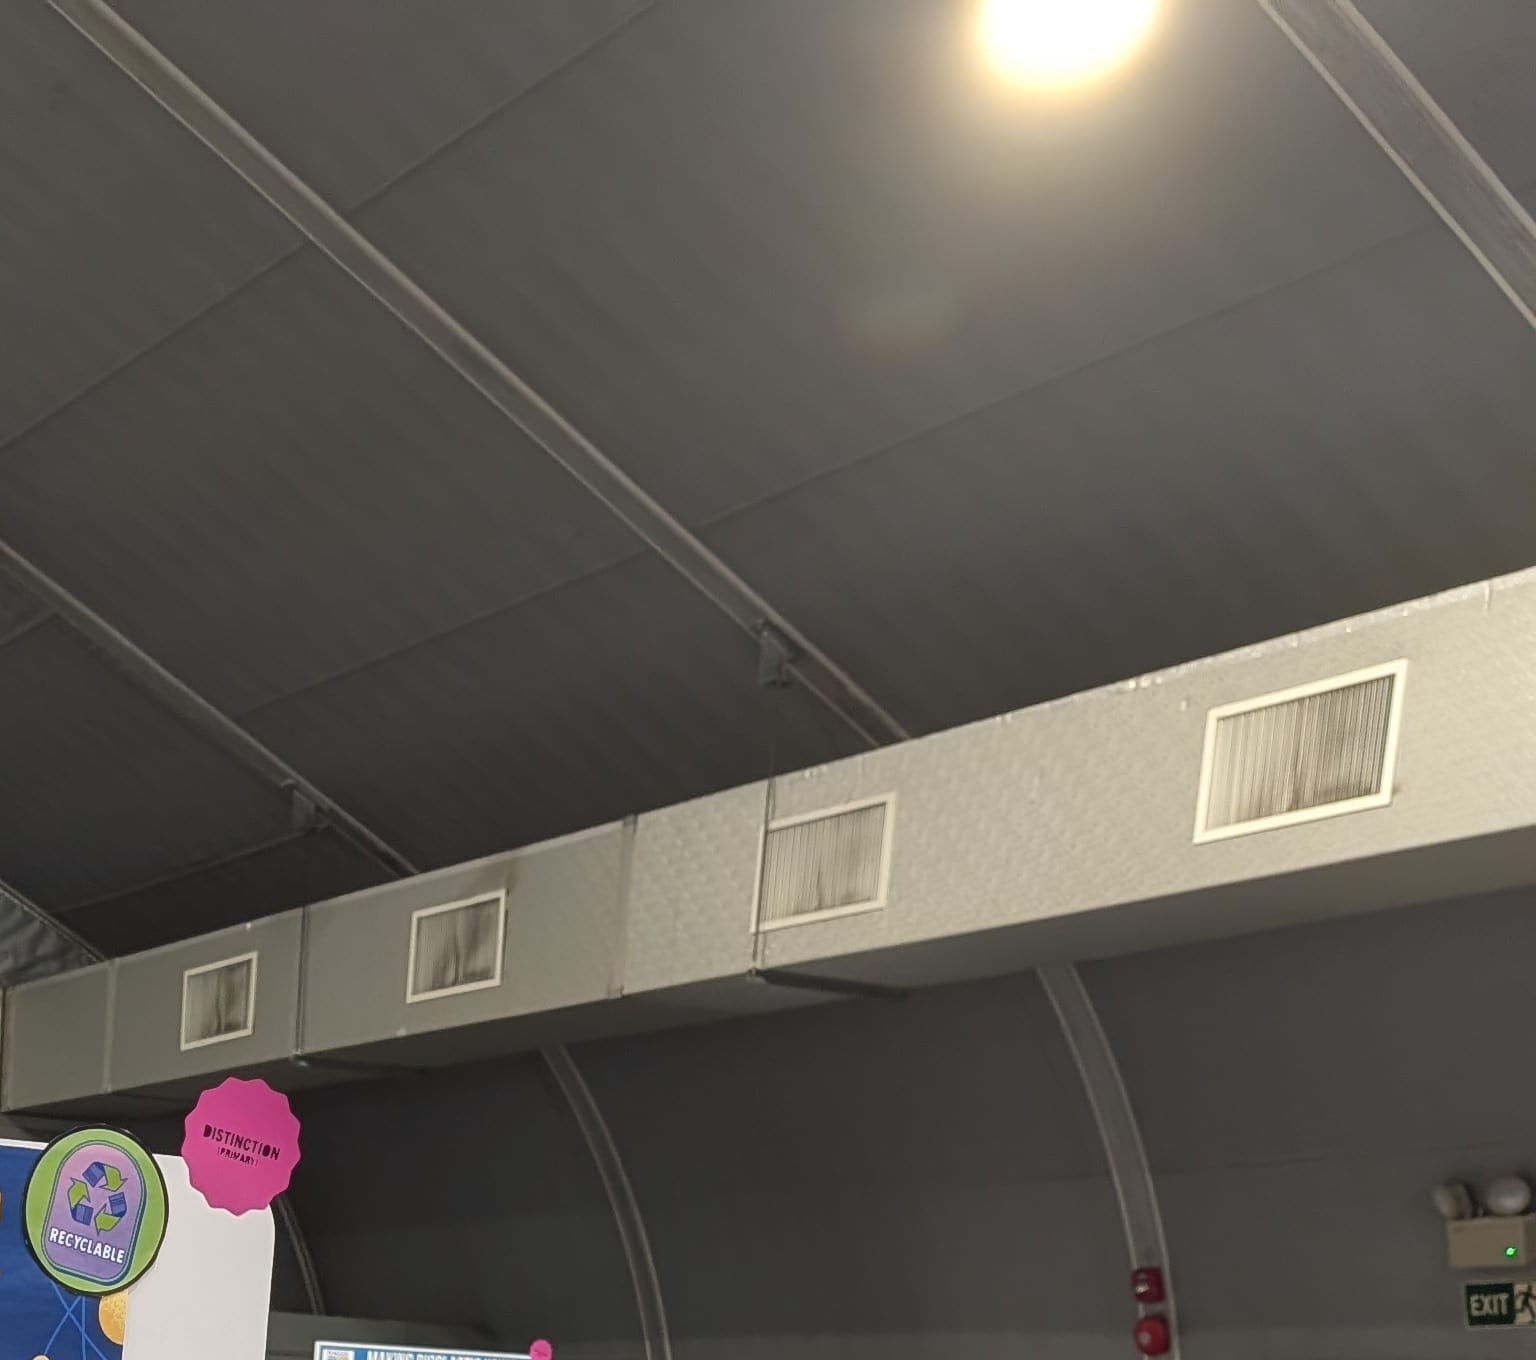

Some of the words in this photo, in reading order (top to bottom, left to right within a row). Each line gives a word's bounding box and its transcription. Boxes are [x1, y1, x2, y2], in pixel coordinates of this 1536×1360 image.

[203, 1124, 280, 1160] DISTINCTION
[48, 1226, 126, 1265] RECYCLABLE
[1468, 1290, 1511, 1319] EXIT
